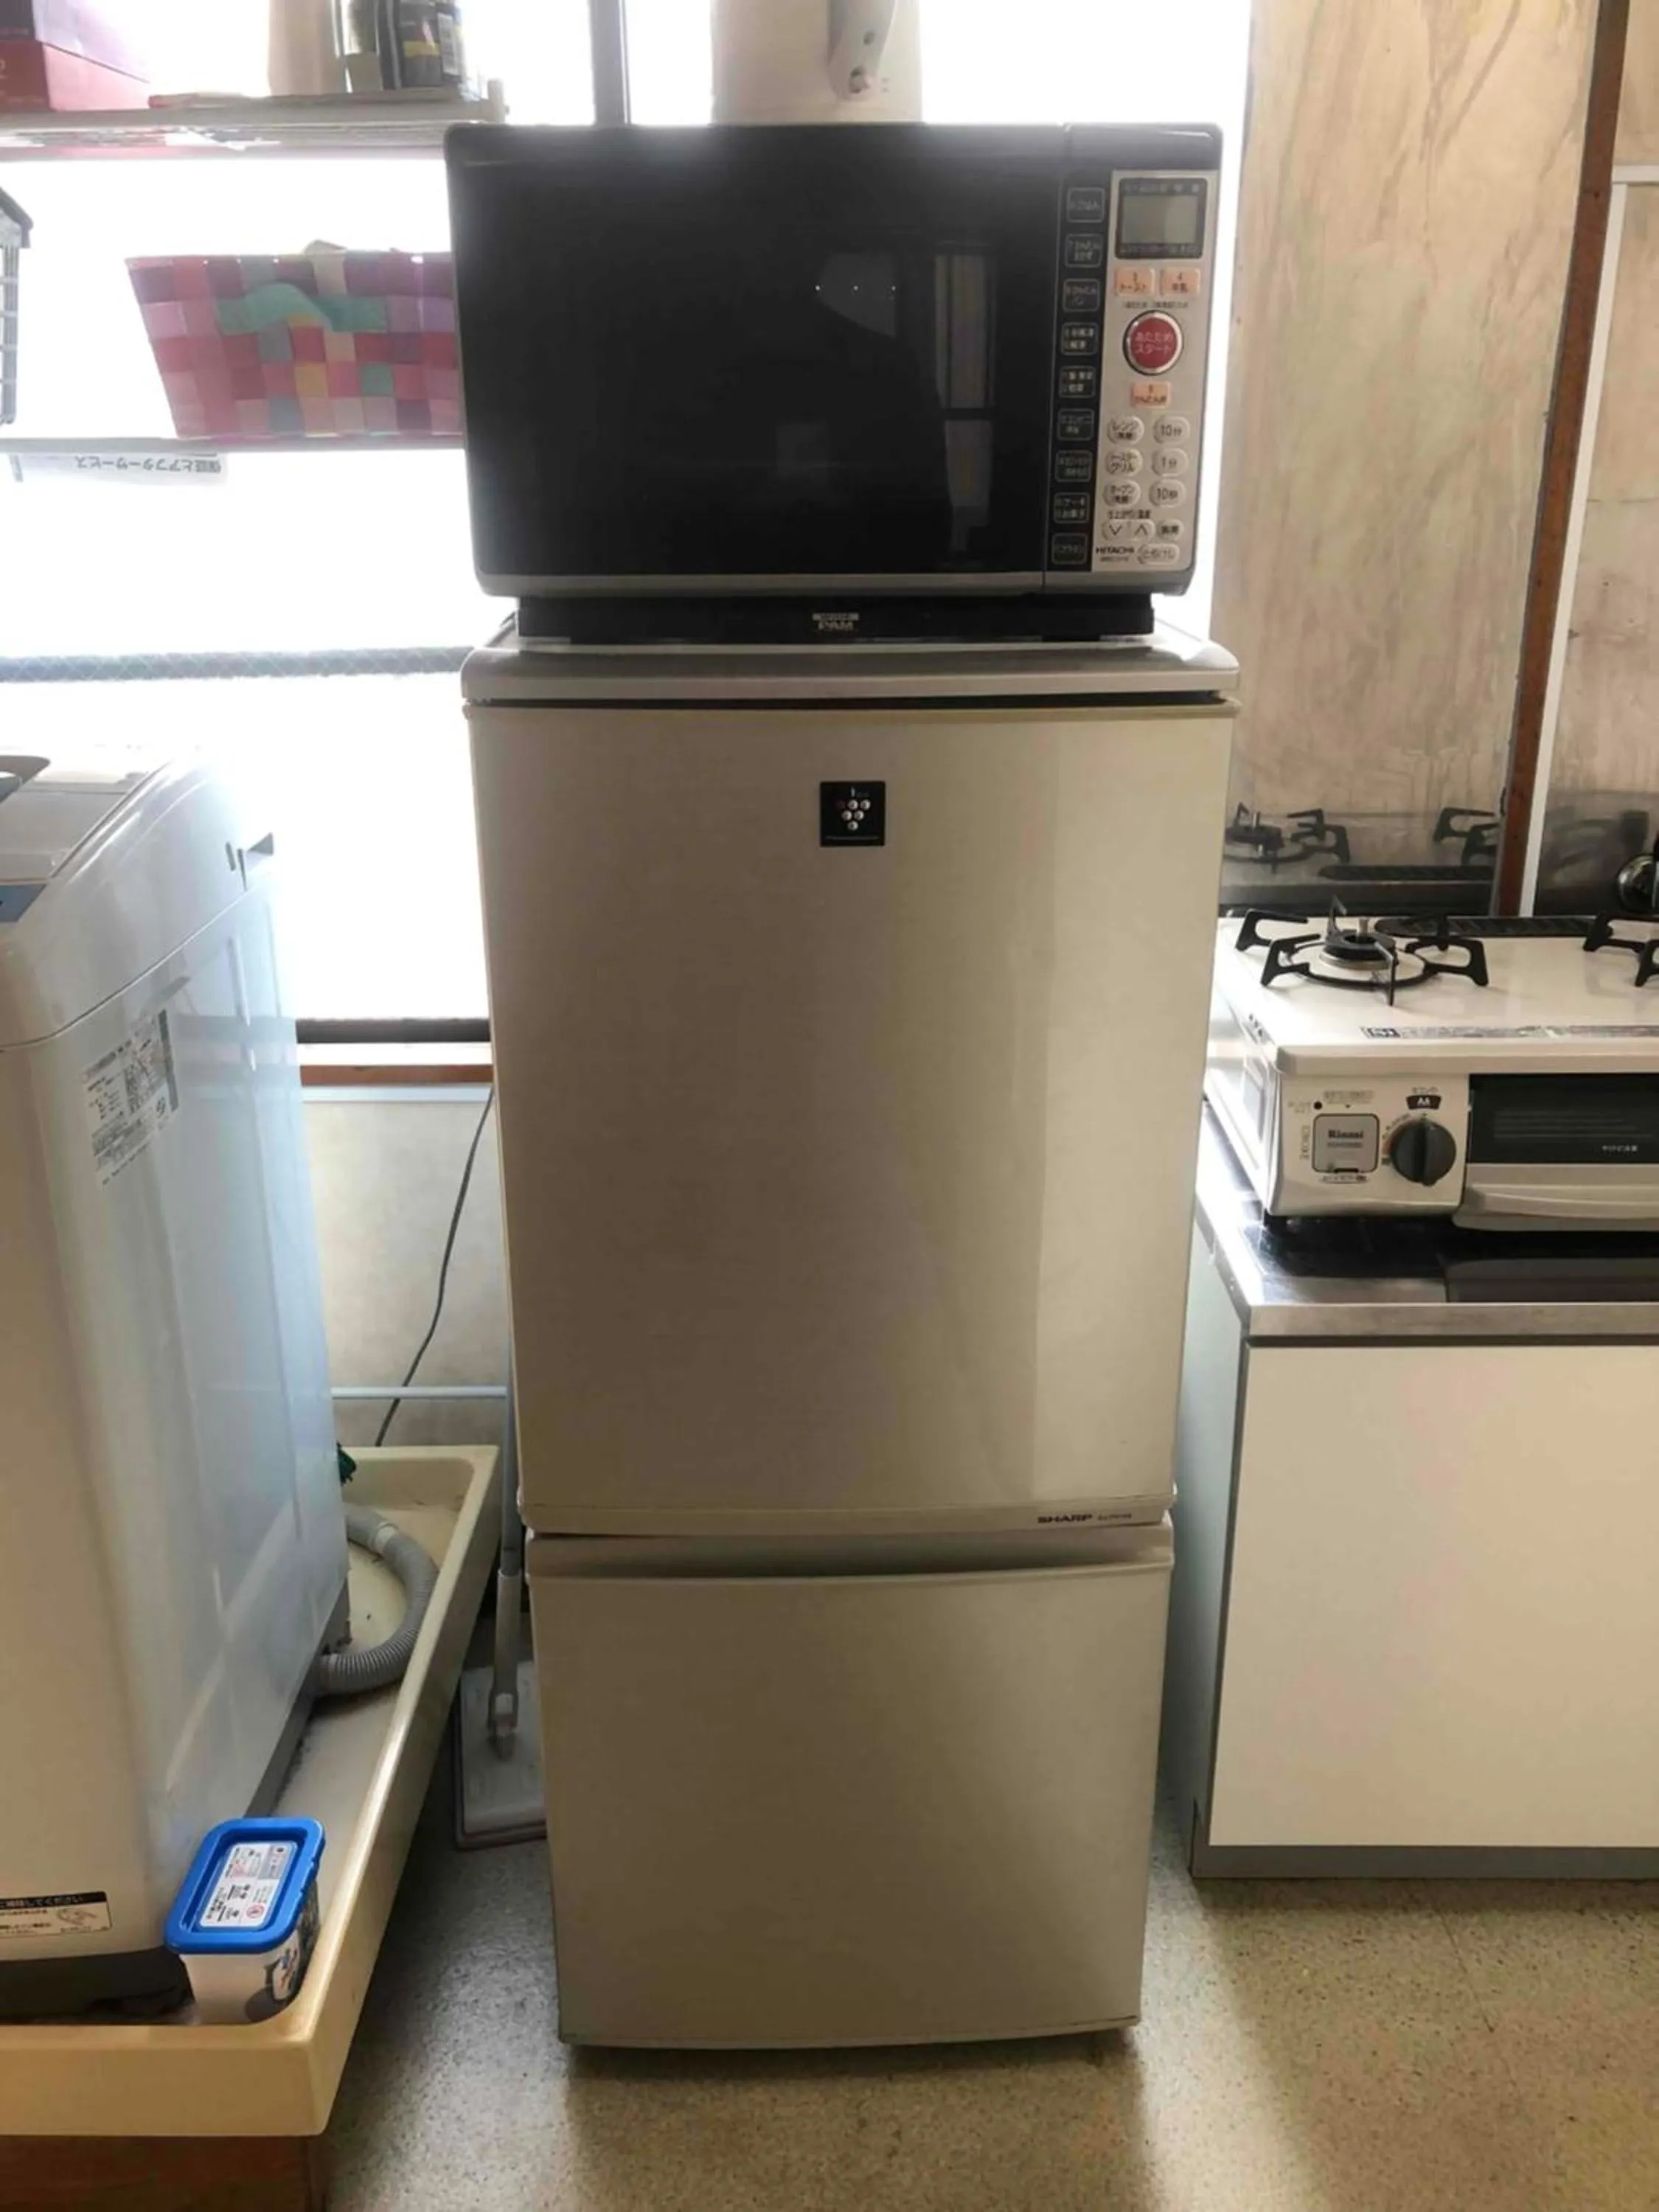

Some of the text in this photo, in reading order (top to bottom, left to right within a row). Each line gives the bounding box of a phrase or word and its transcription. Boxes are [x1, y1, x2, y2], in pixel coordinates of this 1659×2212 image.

[1135, 330, 1174, 342] あたため
[1134, 342, 1172, 355] スタート
[1160, 424, 1182, 437] 10分
[1110, 462, 1135, 473] グリル
[1095, 546, 1135, 555] HITACHI
[1328, 1130, 1364, 1139] Rinnai
[1037, 1514, 1093, 1524] SHARP
